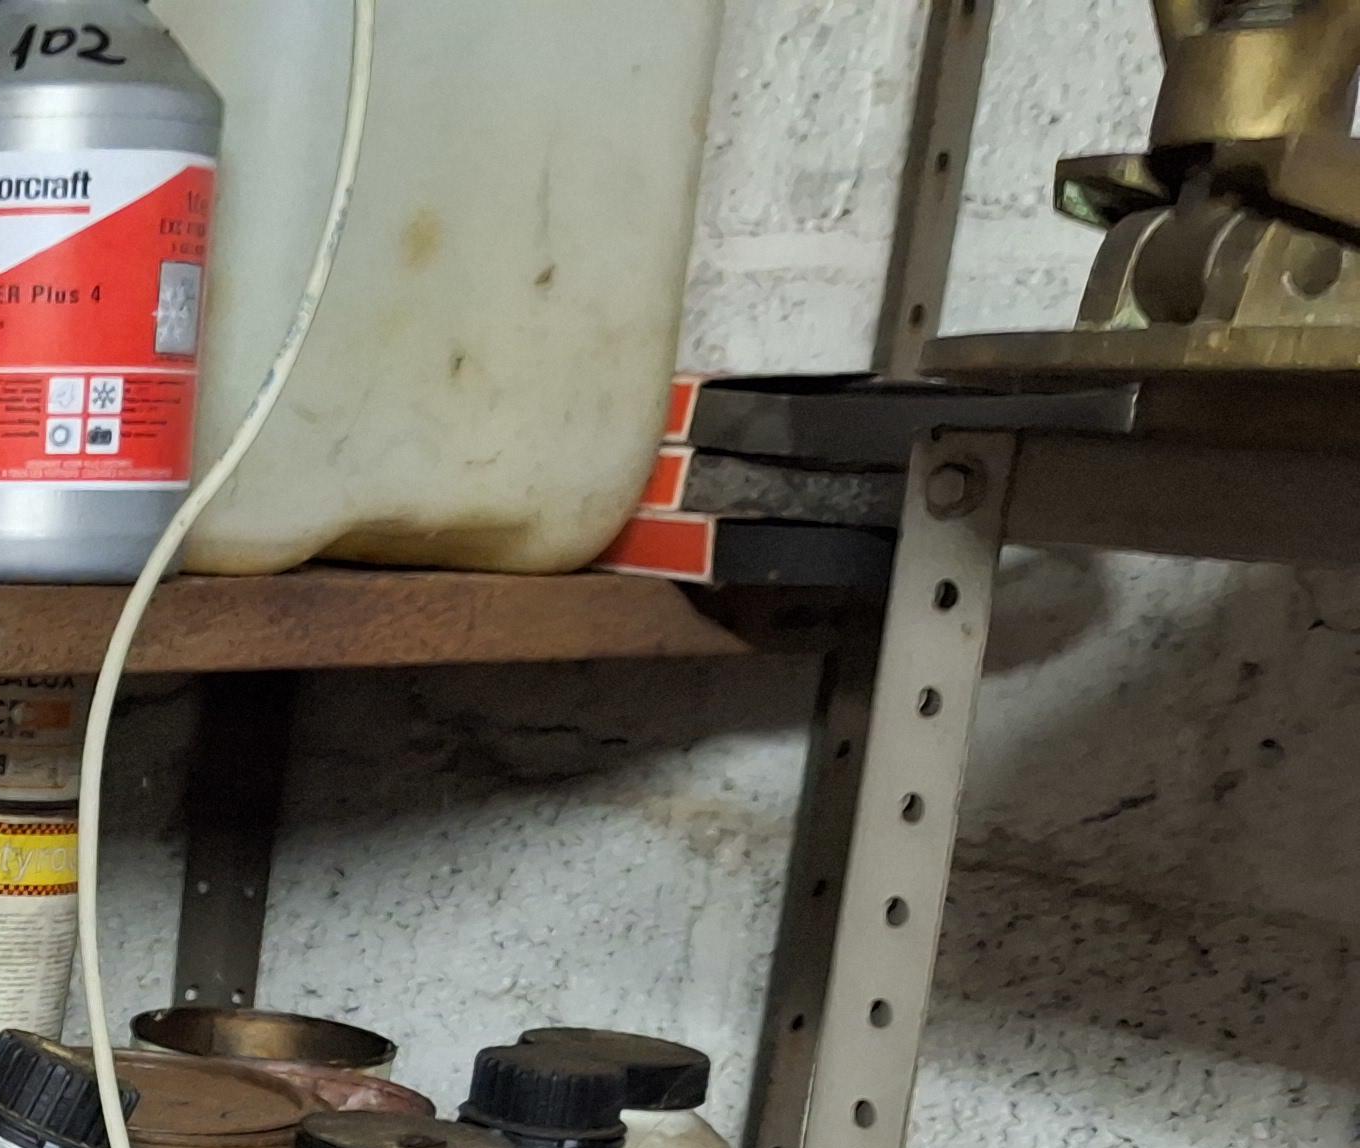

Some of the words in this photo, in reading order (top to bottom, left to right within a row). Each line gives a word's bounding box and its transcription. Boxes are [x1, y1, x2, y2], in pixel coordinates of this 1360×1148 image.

[10, 24, 127, 71] 102
[30, 285, 80, 305] Plus
[90, 285, 102, 302] 4
